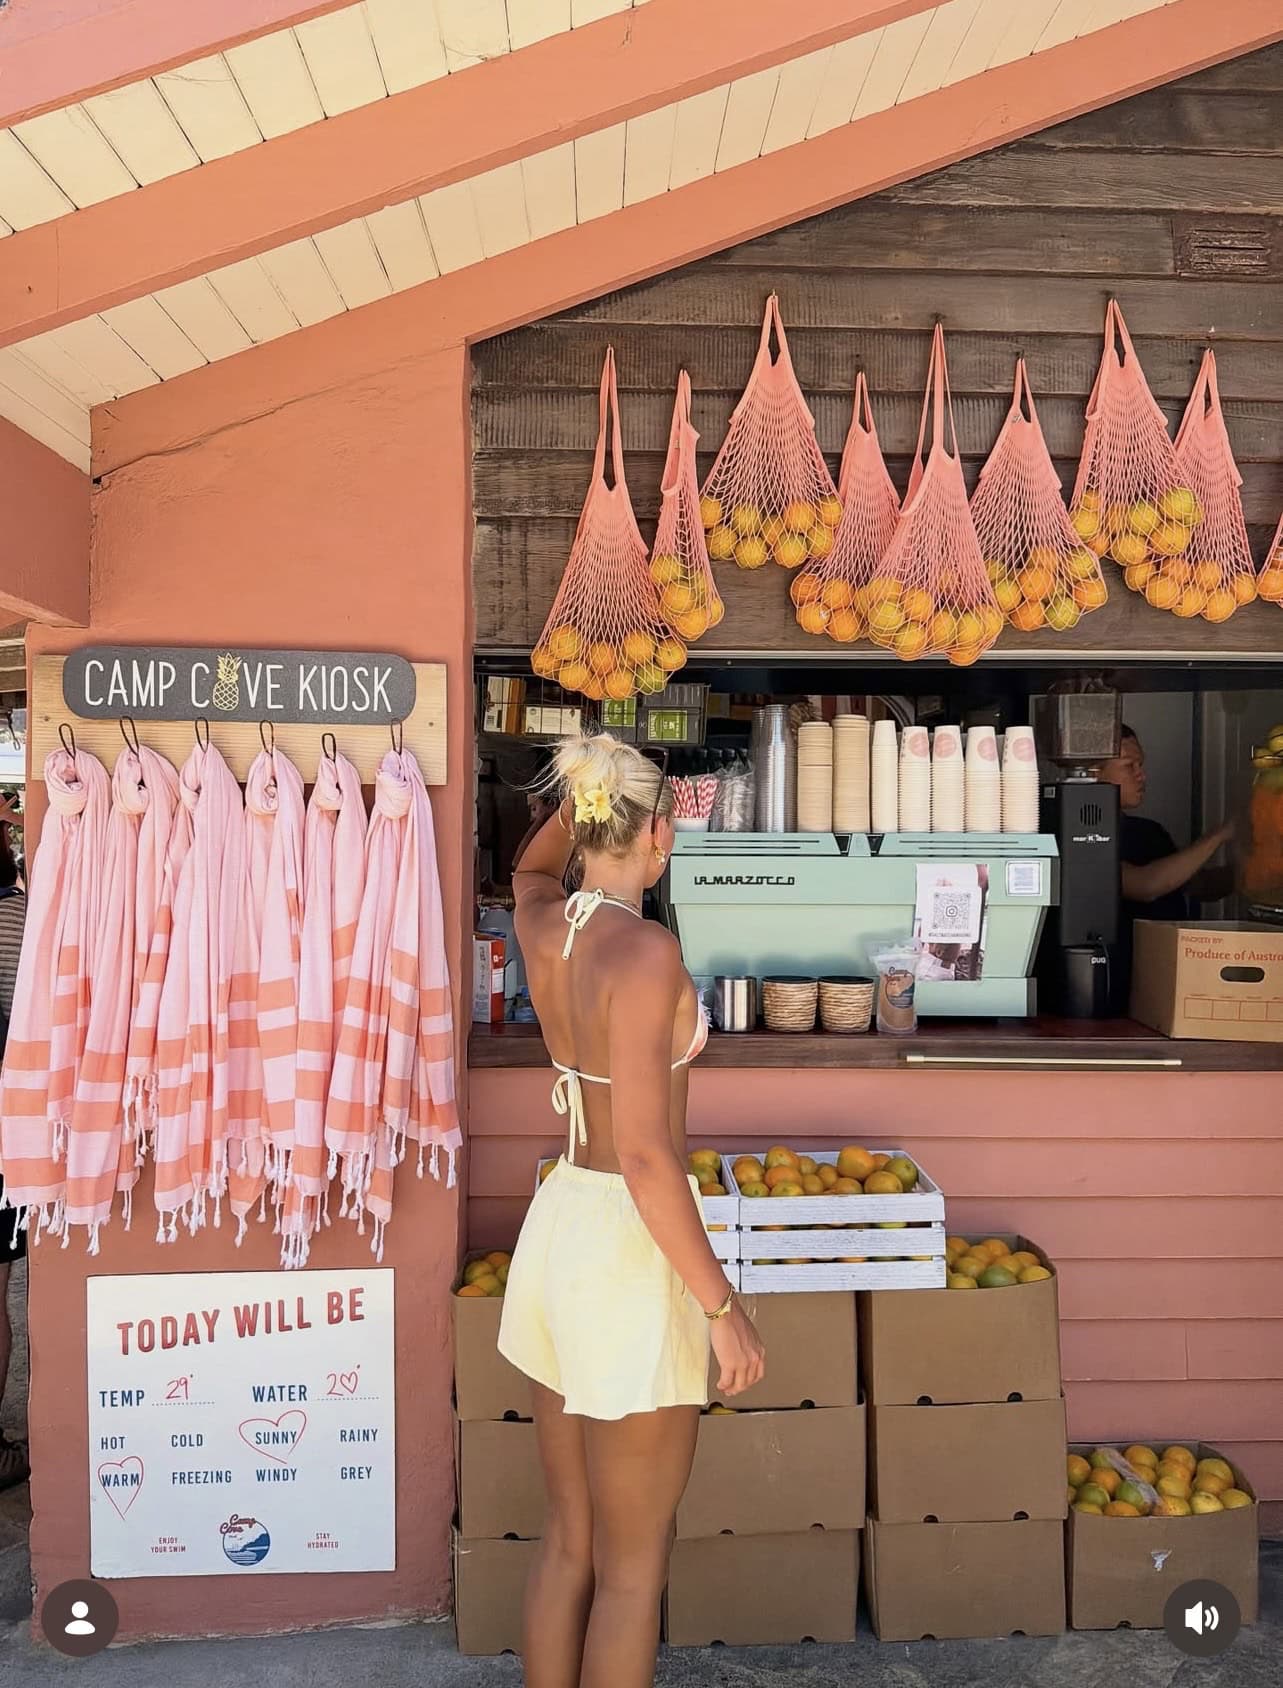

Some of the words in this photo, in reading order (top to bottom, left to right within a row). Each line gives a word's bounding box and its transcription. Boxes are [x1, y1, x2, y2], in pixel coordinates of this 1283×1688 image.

[85, 659, 176, 707] CAMP
[298, 664, 392, 713] KIOSK
[713, 875, 795, 886] MARZOCCO
[1184, 947, 1231, 960] Produce
[1234, 950, 1247, 961] of
[117, 1309, 220, 1356] TODAY
[233, 1296, 312, 1338] WILL
[326, 1287, 365, 1326] BE
[98, 1389, 145, 1408] TEMP
[252, 1384, 308, 1403] WATER
[171, 1433, 203, 1448] COLD
[255, 1431, 297, 1445] SUNNY
[340, 1428, 378, 1442] RAINY
[101, 1436, 125, 1450] HOT
[172, 1470, 232, 1485] FREEZING
[255, 1468, 297, 1482] WINDY
[340, 1466, 372, 1480] GREY
[101, 1473, 140, 1488] WARM
[220, 1522, 244, 1534] Cove
[230, 1514, 256, 1528] Camp
[158, 1537, 178, 1545] ENJOY
[315, 1532, 331, 1540] STAY
[150, 1545, 167, 1553] YOUR
[169, 1545, 186, 1553] SWIM
[307, 1541, 339, 1549] HYDRATED
